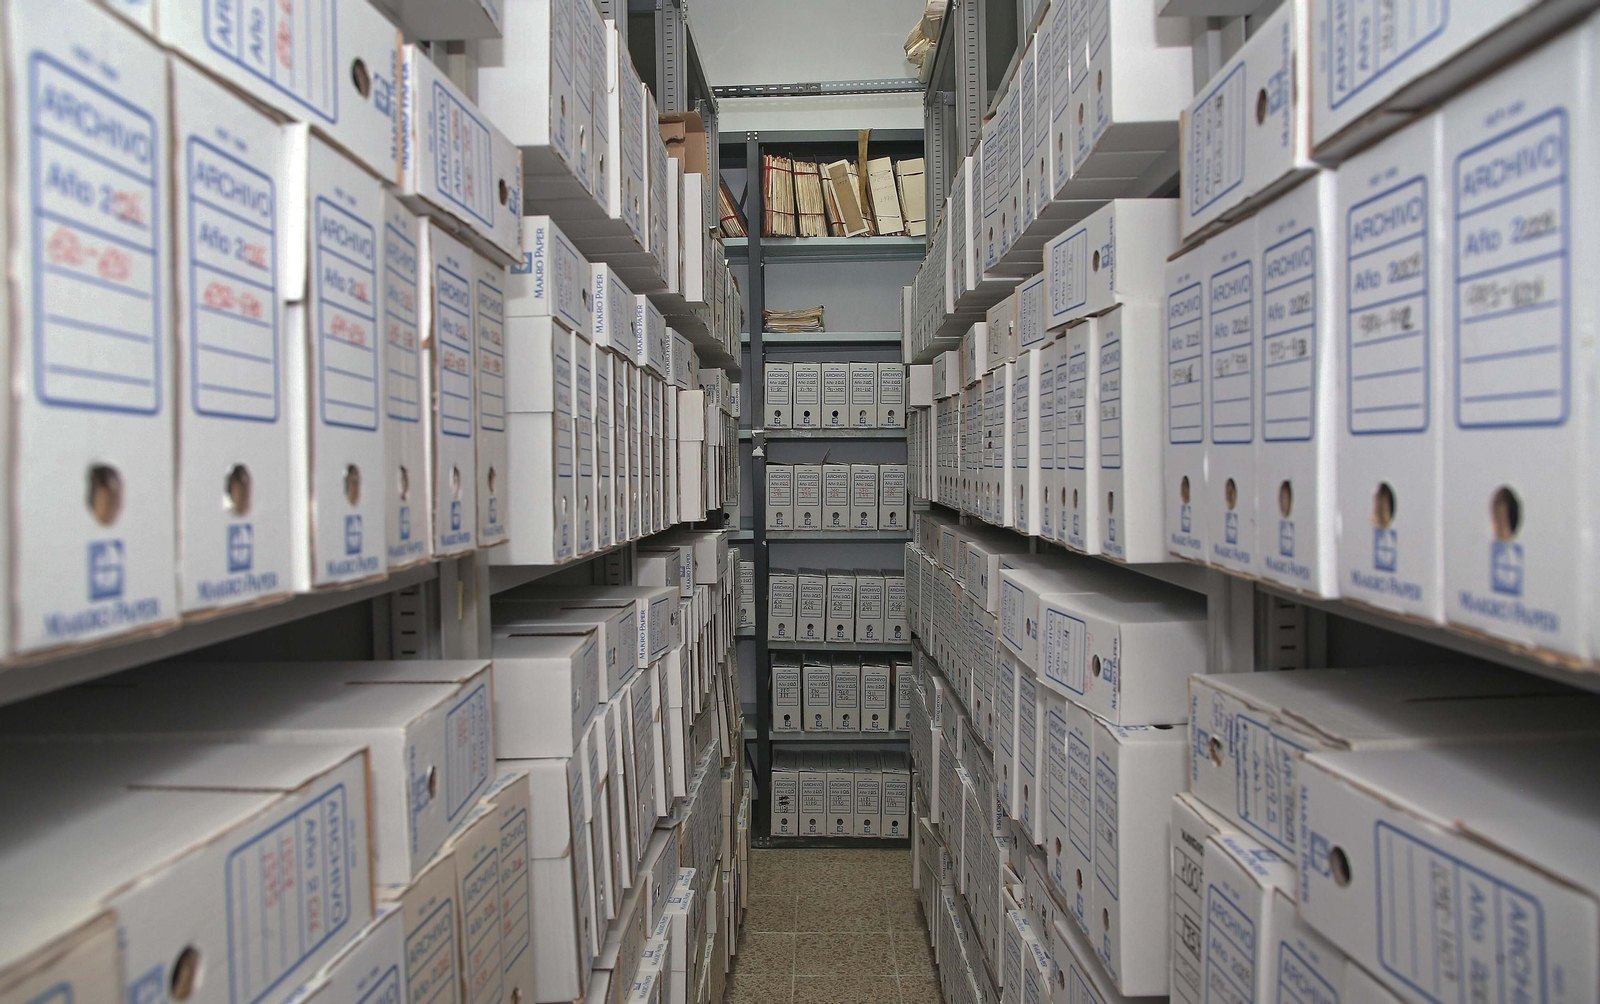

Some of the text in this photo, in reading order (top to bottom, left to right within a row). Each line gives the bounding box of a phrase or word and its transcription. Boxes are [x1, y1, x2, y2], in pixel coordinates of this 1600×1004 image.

[195, 160, 272, 218] ARCHIVO
[1462, 133, 1561, 197] ARCHIVO
[198, 222, 233, 255] Año
[1353, 195, 1425, 244] ARCHIVO
[1464, 227, 1503, 256] Año
[534, 227, 545, 299] MAKRO PAPER
[1265, 241, 1313, 281] ARCHIVO
[1353, 268, 1382, 293] Año
[595, 273, 604, 333] MAKRO PAPER
[1170, 295, 1200, 319] ARCHIVO
[1213, 274, 1249, 301] ARCHIVO
[1267, 301, 1286, 321] Año
[1214, 322, 1230, 338] Año
[305, 818, 318, 869] Año
[328, 800, 344, 924] ARCHIVO
[408, 912, 451, 963] ARCHIVO
[1211, 900, 1251, 949] ARCHIVO
[1508, 897, 1532, 1004] ARCH
